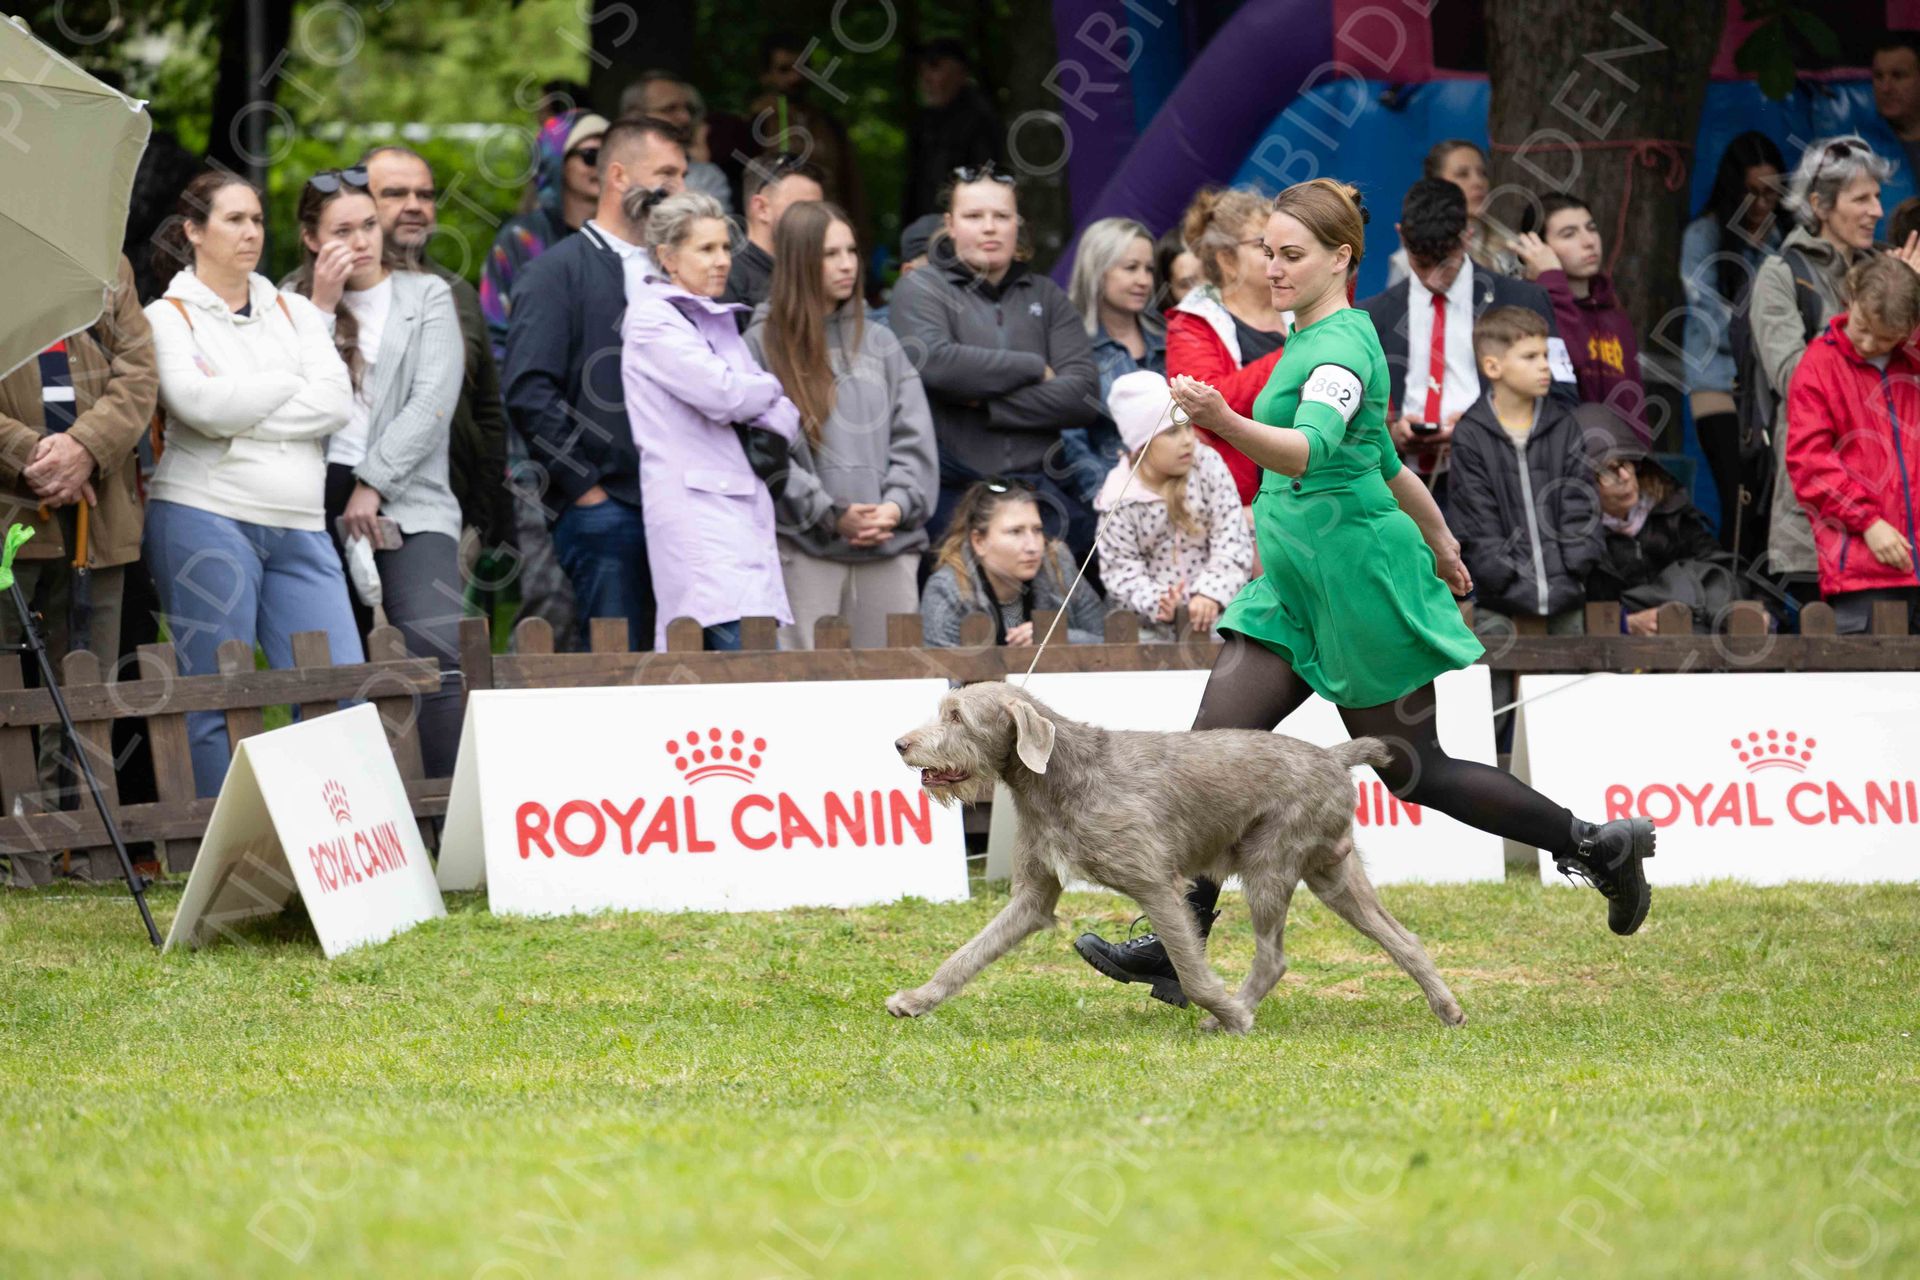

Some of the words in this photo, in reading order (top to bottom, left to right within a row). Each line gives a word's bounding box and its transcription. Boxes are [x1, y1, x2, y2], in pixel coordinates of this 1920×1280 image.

[1312, 378, 1352, 408] 862
[515, 795, 716, 859] ROYAL
[731, 789, 932, 850] CANIN
[1605, 782, 1774, 828] ROYAL
[1787, 780, 1919, 825] CANI
[308, 836, 363, 894] ROYAL
[354, 820, 408, 878] CANIN
